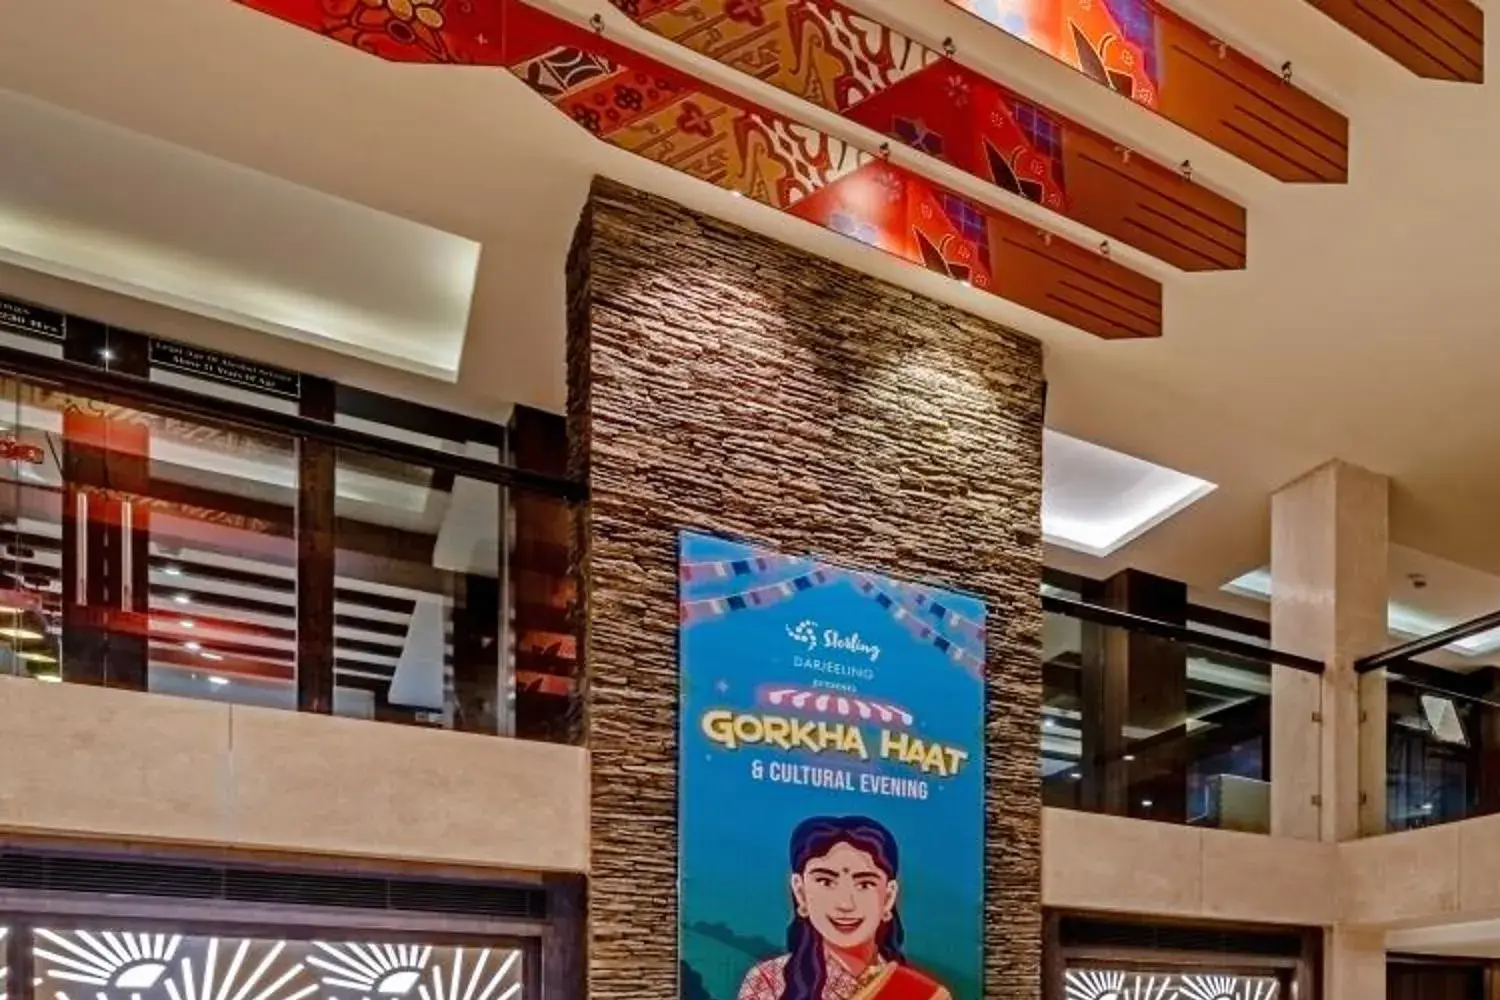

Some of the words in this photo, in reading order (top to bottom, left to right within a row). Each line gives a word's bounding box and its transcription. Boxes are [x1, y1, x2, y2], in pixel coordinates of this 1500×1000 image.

[793, 656, 874, 680] DARJEELING
[701, 709, 869, 760] GORKHA
[880, 729, 969, 777] HAAT
[751, 760, 765, 780] &
[769, 762, 854, 792] CULTURAL
[860, 774, 929, 800] EVENING
